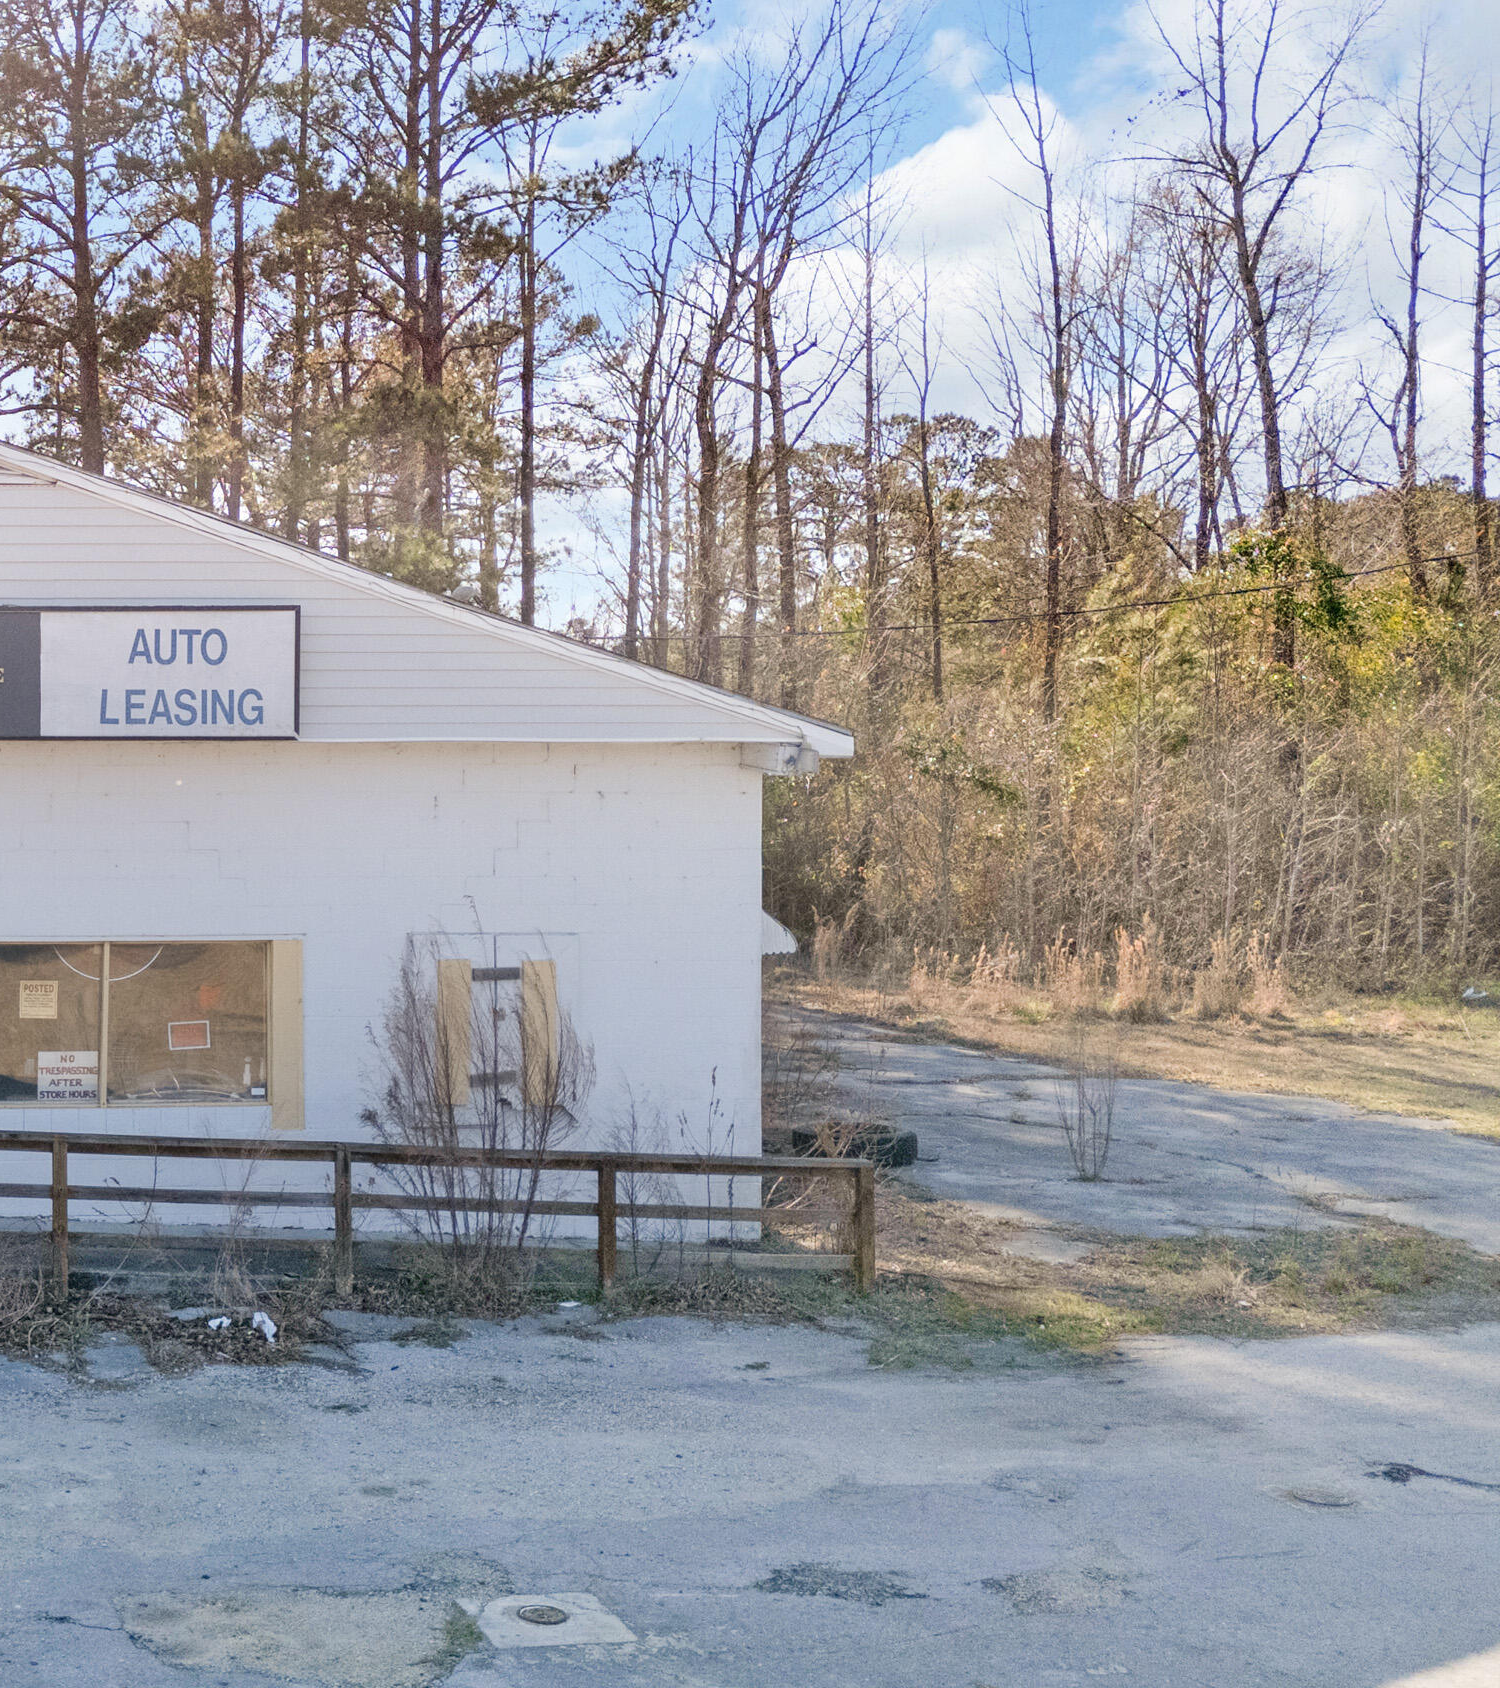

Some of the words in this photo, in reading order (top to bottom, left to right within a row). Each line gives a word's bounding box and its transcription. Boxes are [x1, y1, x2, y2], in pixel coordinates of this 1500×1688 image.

[128, 628, 228, 666] AUTO
[99, 688, 265, 726] LEASING
[23, 983, 55, 993] POSTED
[60, 1054, 76, 1063] NO
[39, 1066, 99, 1075] TRESPASSING
[48, 1078, 83, 1087] AFTER
[39, 1090, 68, 1099] STORE
[68, 1090, 97, 1099] HOURS
